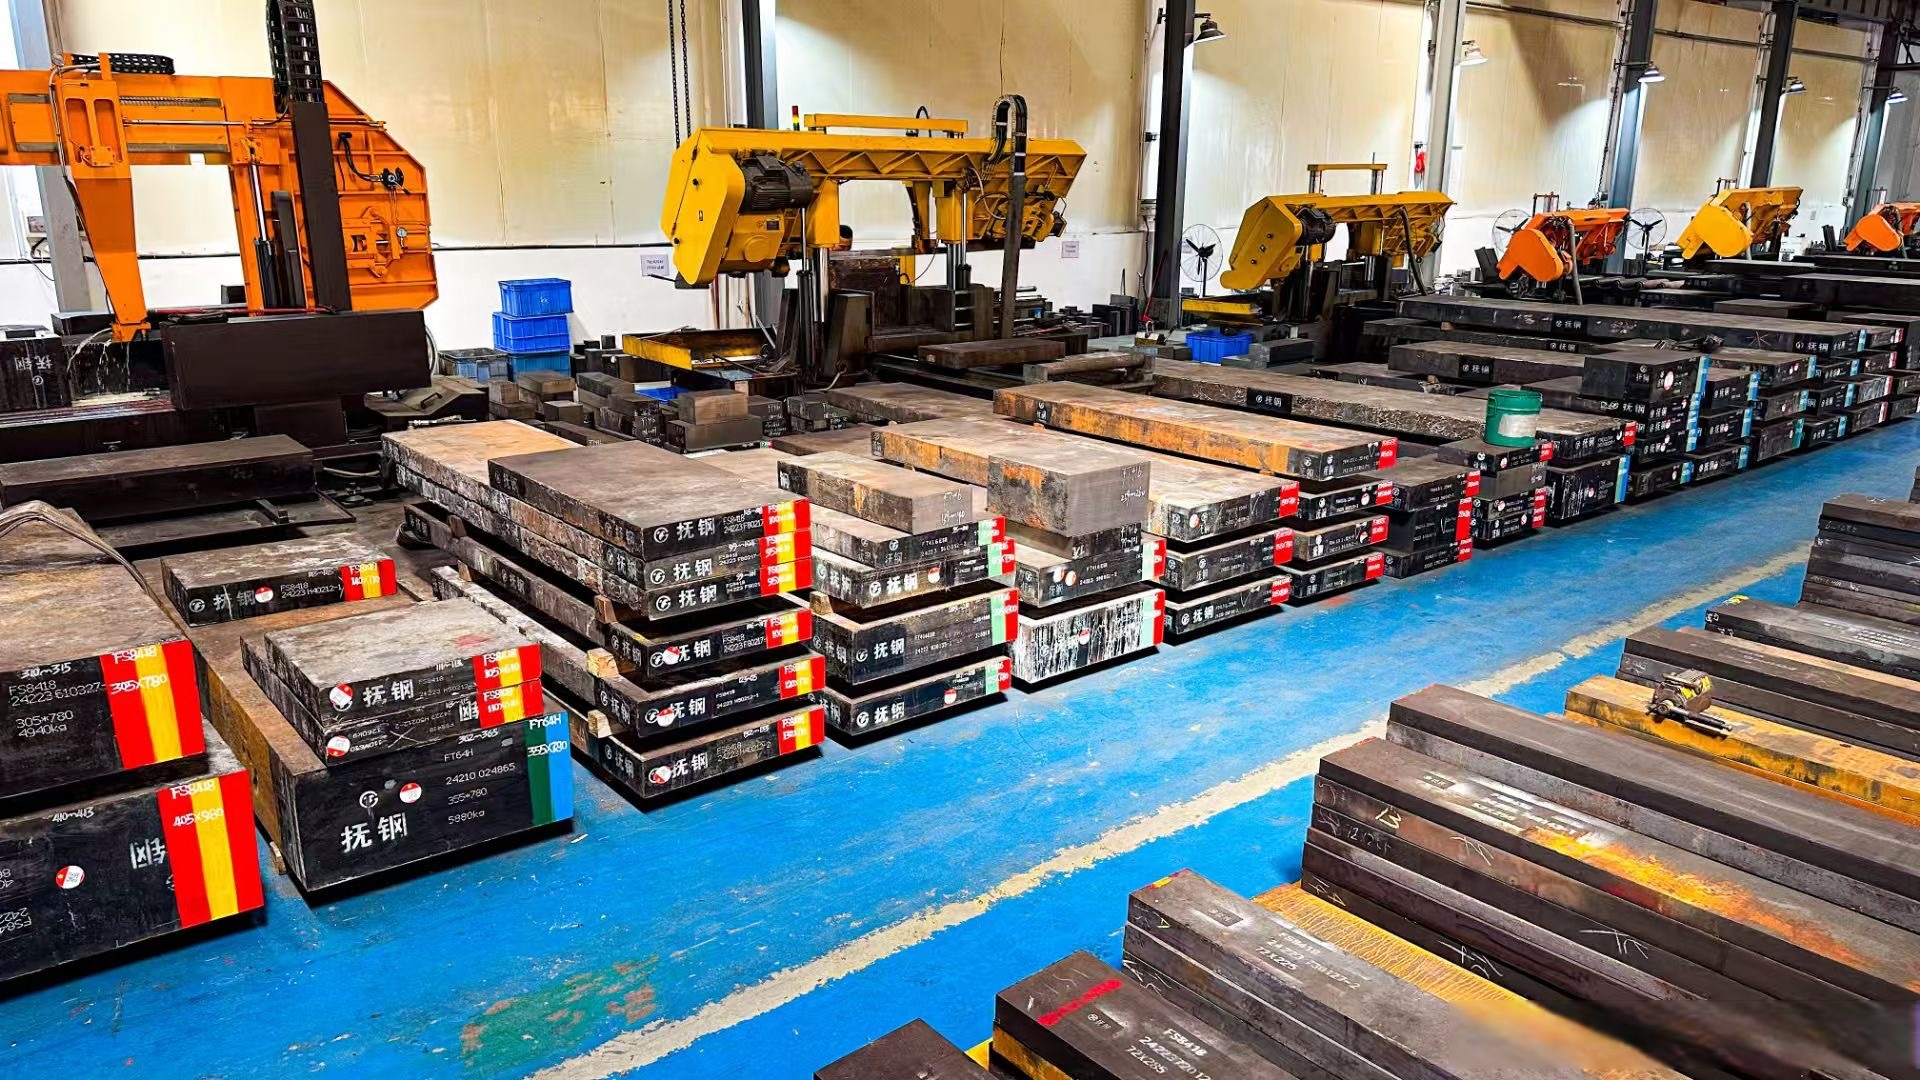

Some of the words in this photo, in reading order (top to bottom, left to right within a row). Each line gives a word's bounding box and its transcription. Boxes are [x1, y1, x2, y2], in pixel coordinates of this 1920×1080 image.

[677, 517, 716, 541] 抚钢
[673, 558, 713, 582] 抚钢
[887, 573, 917, 595] 抚钢
[679, 584, 717, 609] 抚钢
[874, 638, 905, 660] 抚钢
[9, 680, 57, 696] FS8418
[10, 691, 53, 706] 24223
[363, 679, 414, 708] 抚钢
[874, 702, 905, 724] 抚钢
[444, 748, 474, 763] FT64H
[670, 752, 709, 778] 抚钢
[446, 770, 476, 786] 24210
[478, 763, 516, 779] 024865
[340, 812, 408, 853] 抚钢
